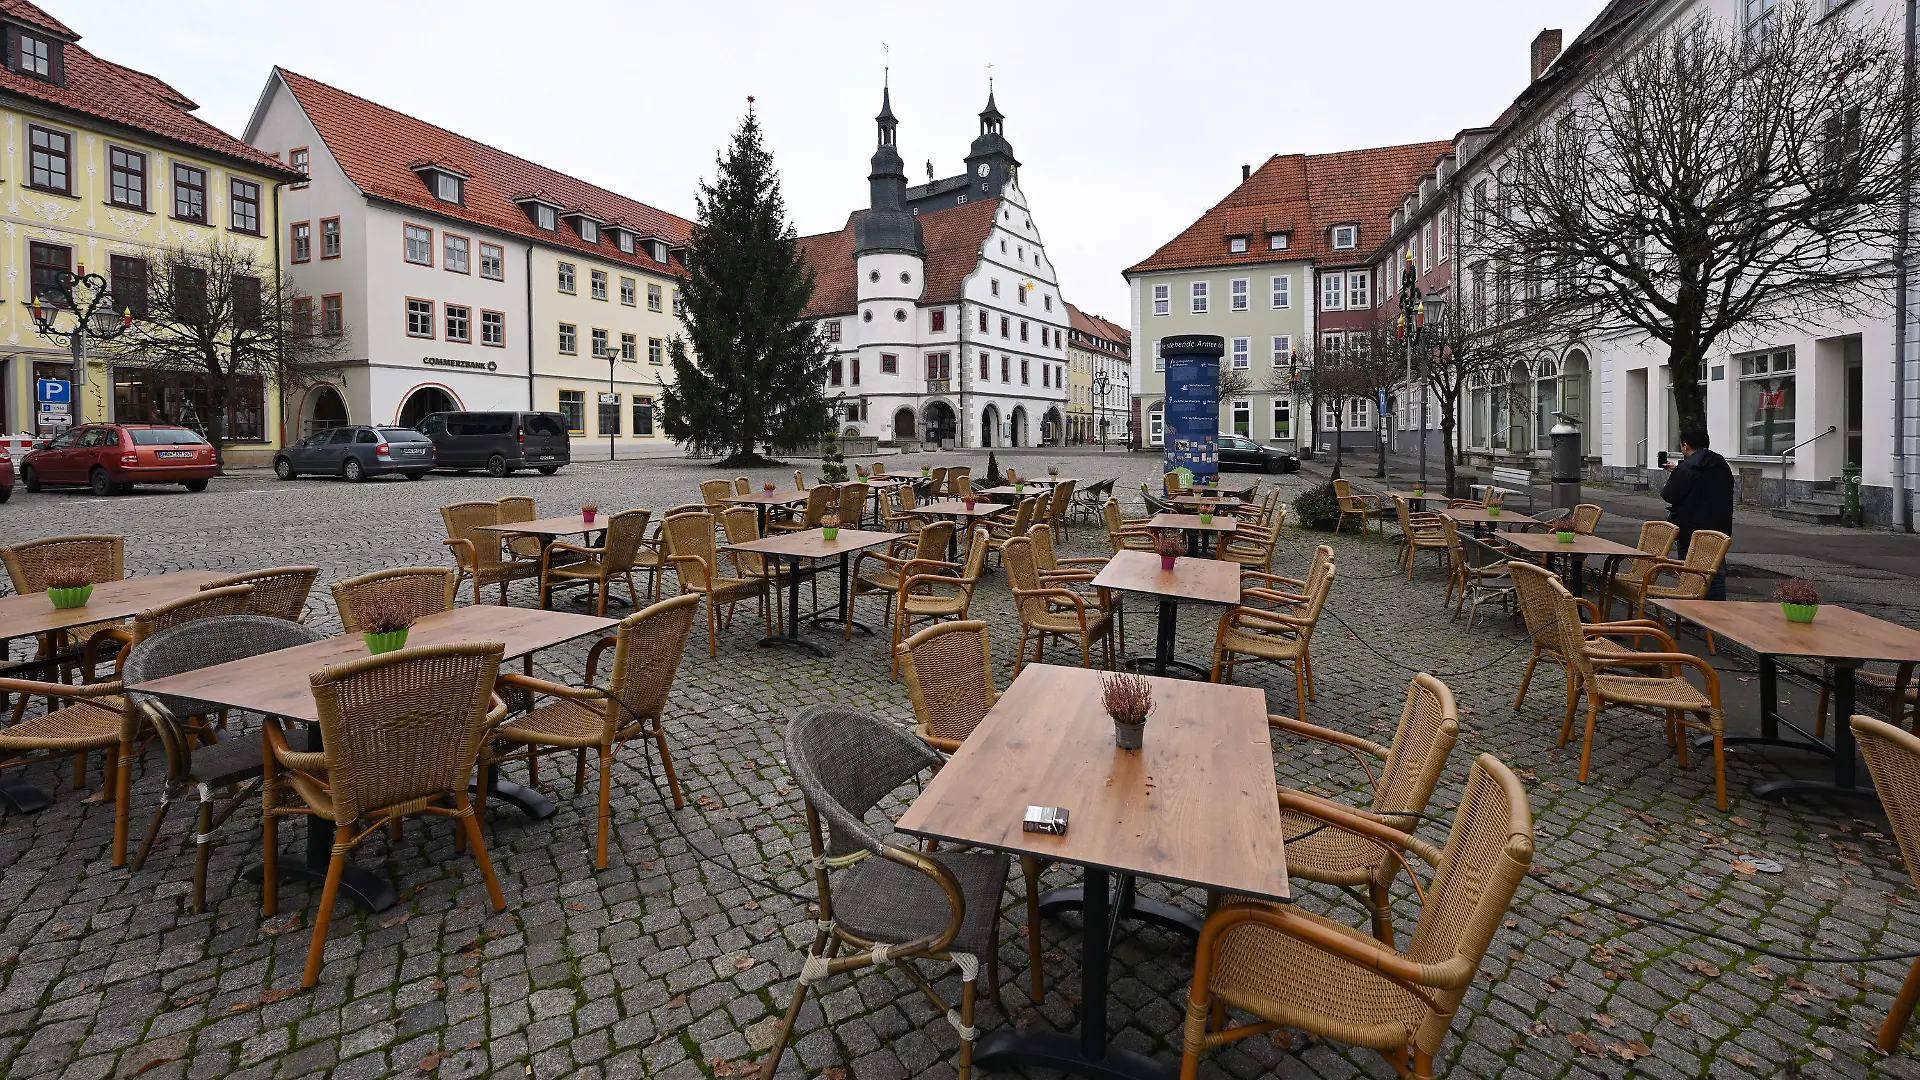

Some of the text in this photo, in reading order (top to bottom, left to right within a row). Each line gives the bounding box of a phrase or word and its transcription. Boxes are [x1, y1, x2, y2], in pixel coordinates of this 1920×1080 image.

[1196, 340, 1217, 348] Armee
[423, 357, 487, 369] COMMERZBANK
[46, 382, 63, 400] P
